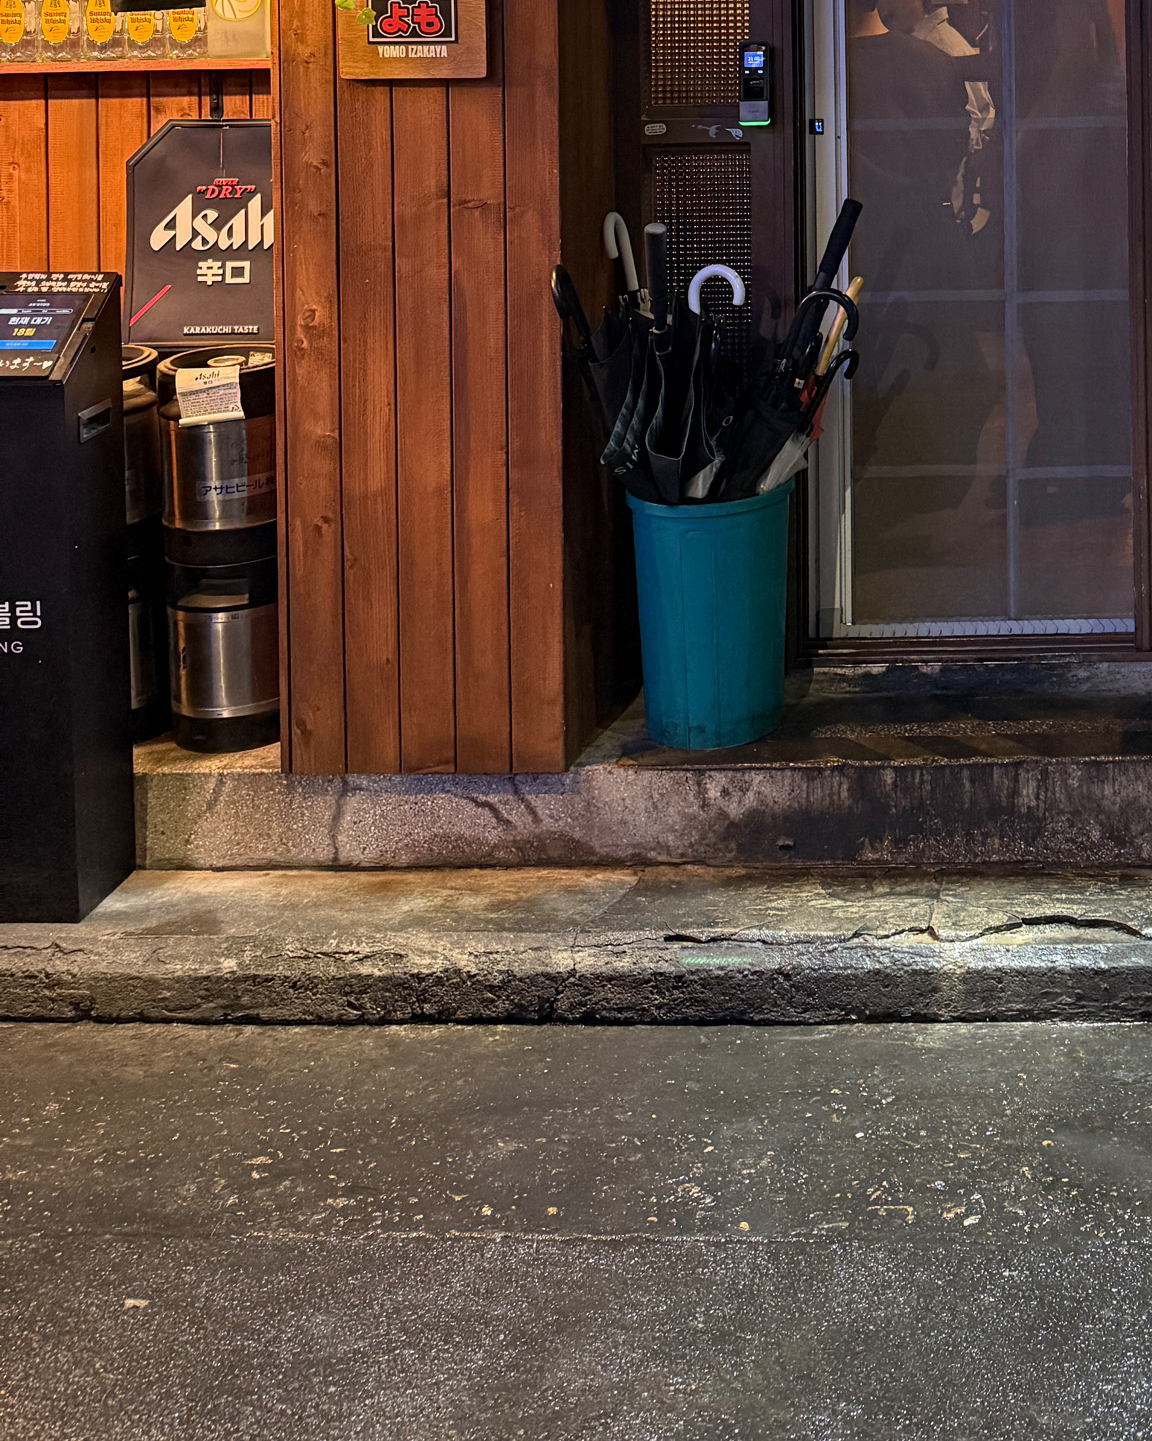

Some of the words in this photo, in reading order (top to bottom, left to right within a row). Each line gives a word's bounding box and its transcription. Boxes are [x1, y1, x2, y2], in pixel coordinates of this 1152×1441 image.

[379, 0, 444, 36] よも
[378, 45, 406, 58] YOMO
[408, 45, 448, 58] IZAKAYA
[150, 193, 275, 252] Asah
[196, 259, 250, 286] 辛口
[31, 316, 53, 325] 대기
[183, 325, 232, 335] KARAKUCHI
[234, 325, 259, 334] TASTE
